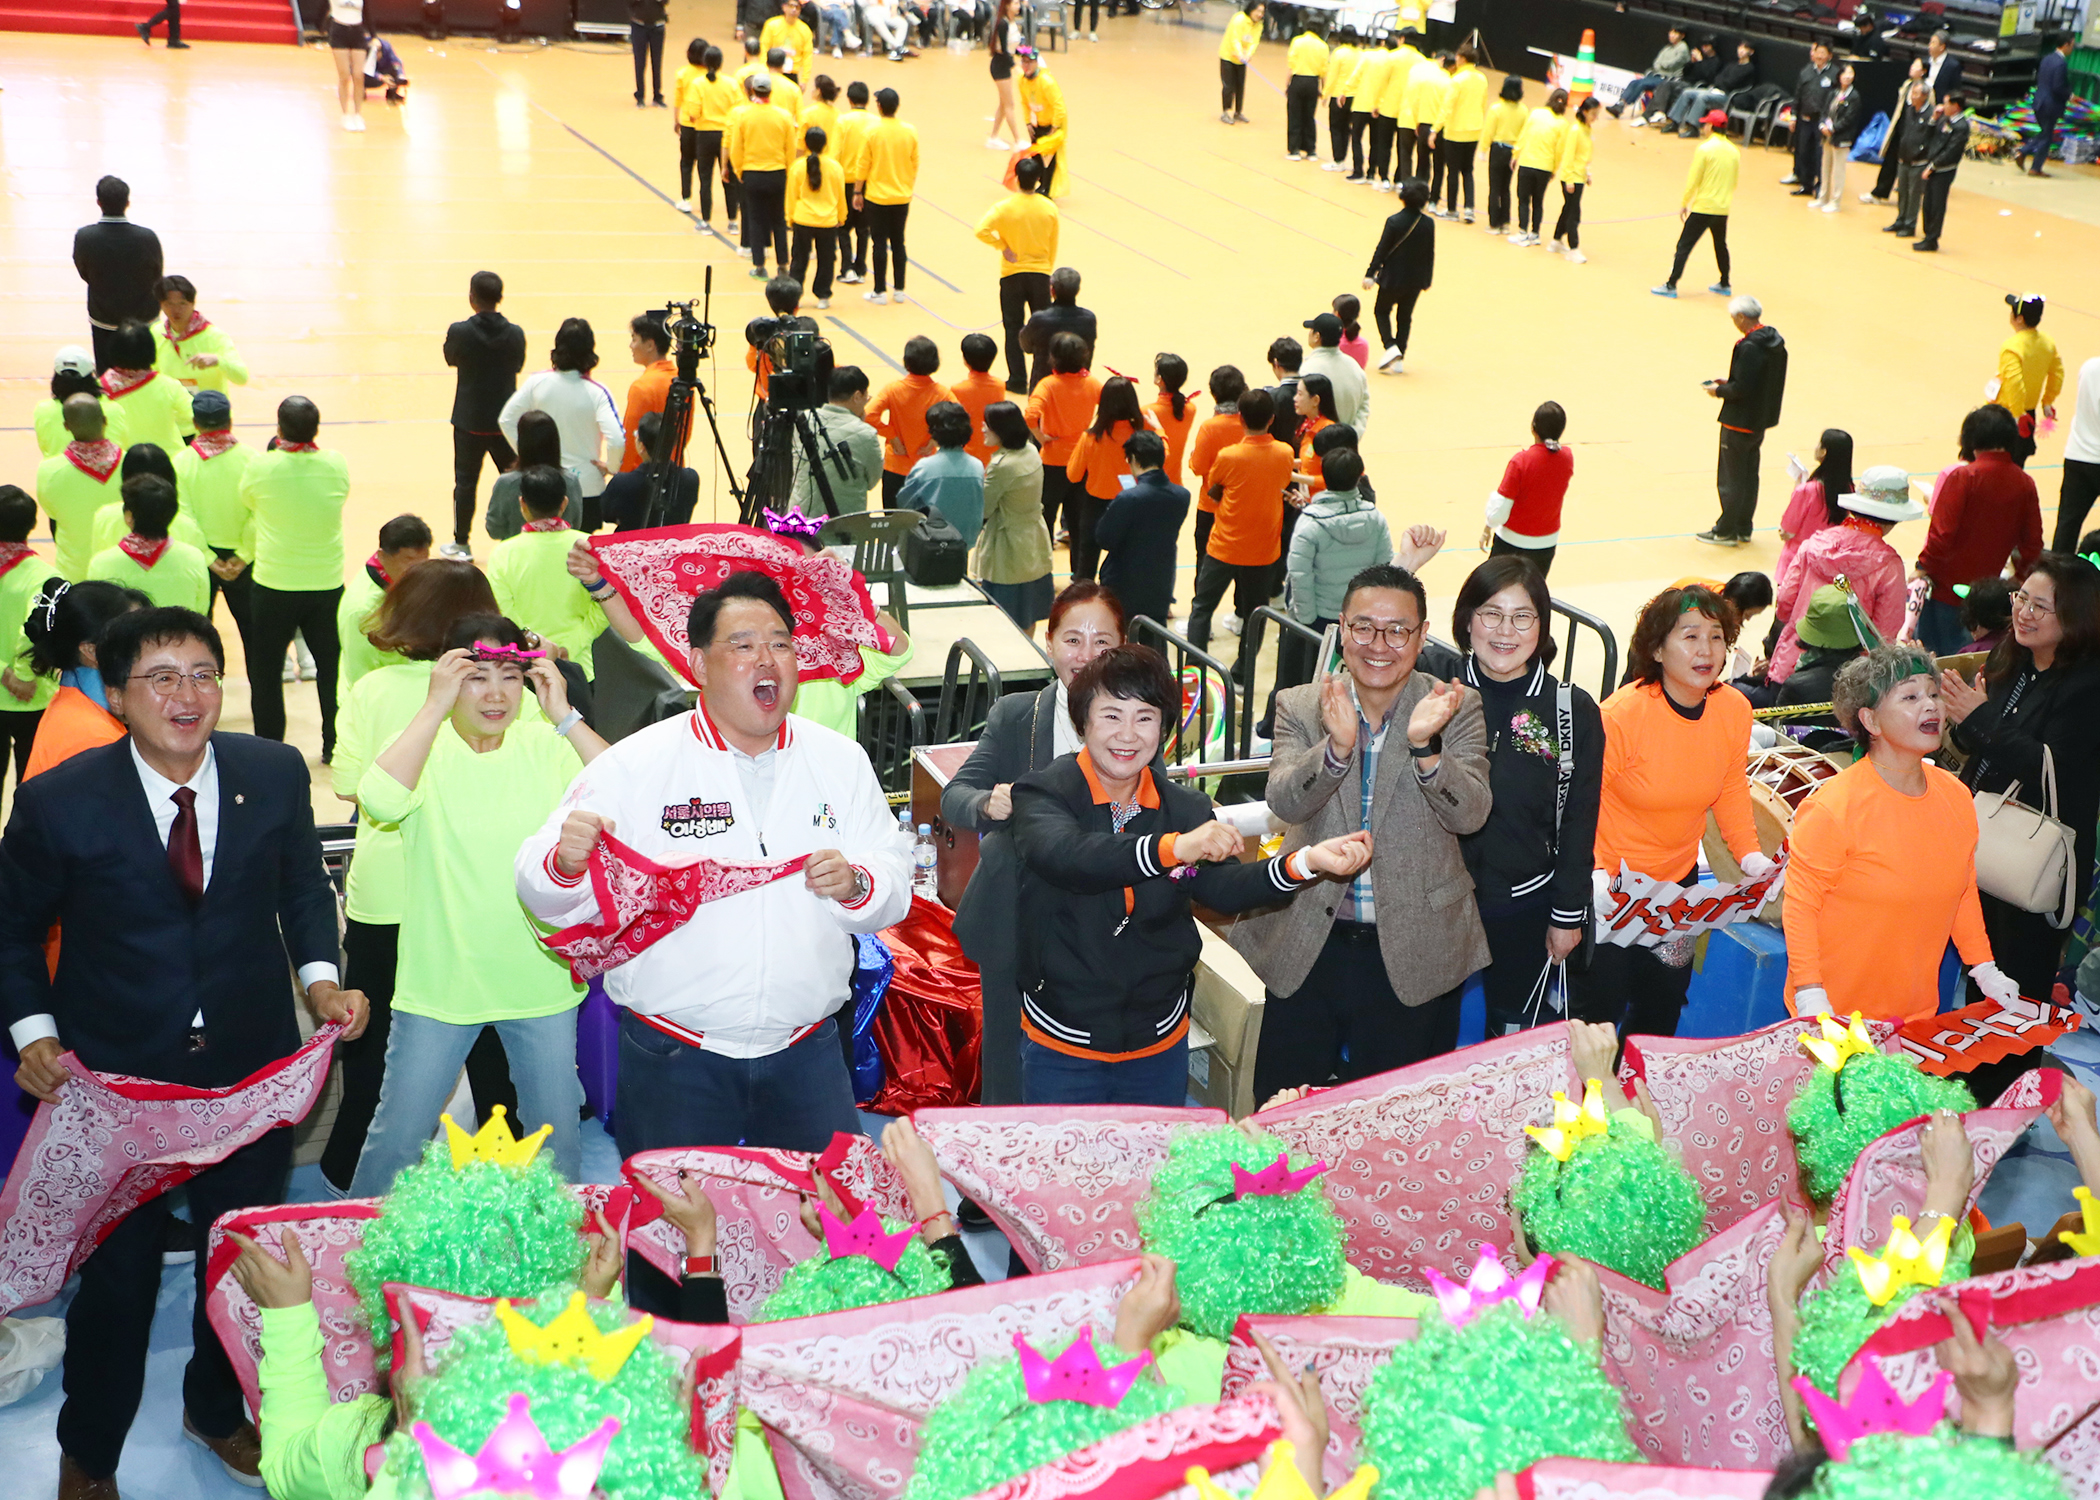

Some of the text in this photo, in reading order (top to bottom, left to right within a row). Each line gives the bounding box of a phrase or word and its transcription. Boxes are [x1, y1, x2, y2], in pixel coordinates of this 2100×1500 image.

[1559, 708, 1572, 752] DKNY
[663, 803, 732, 820] 서울시의원
[670, 818, 727, 838] 이성배
